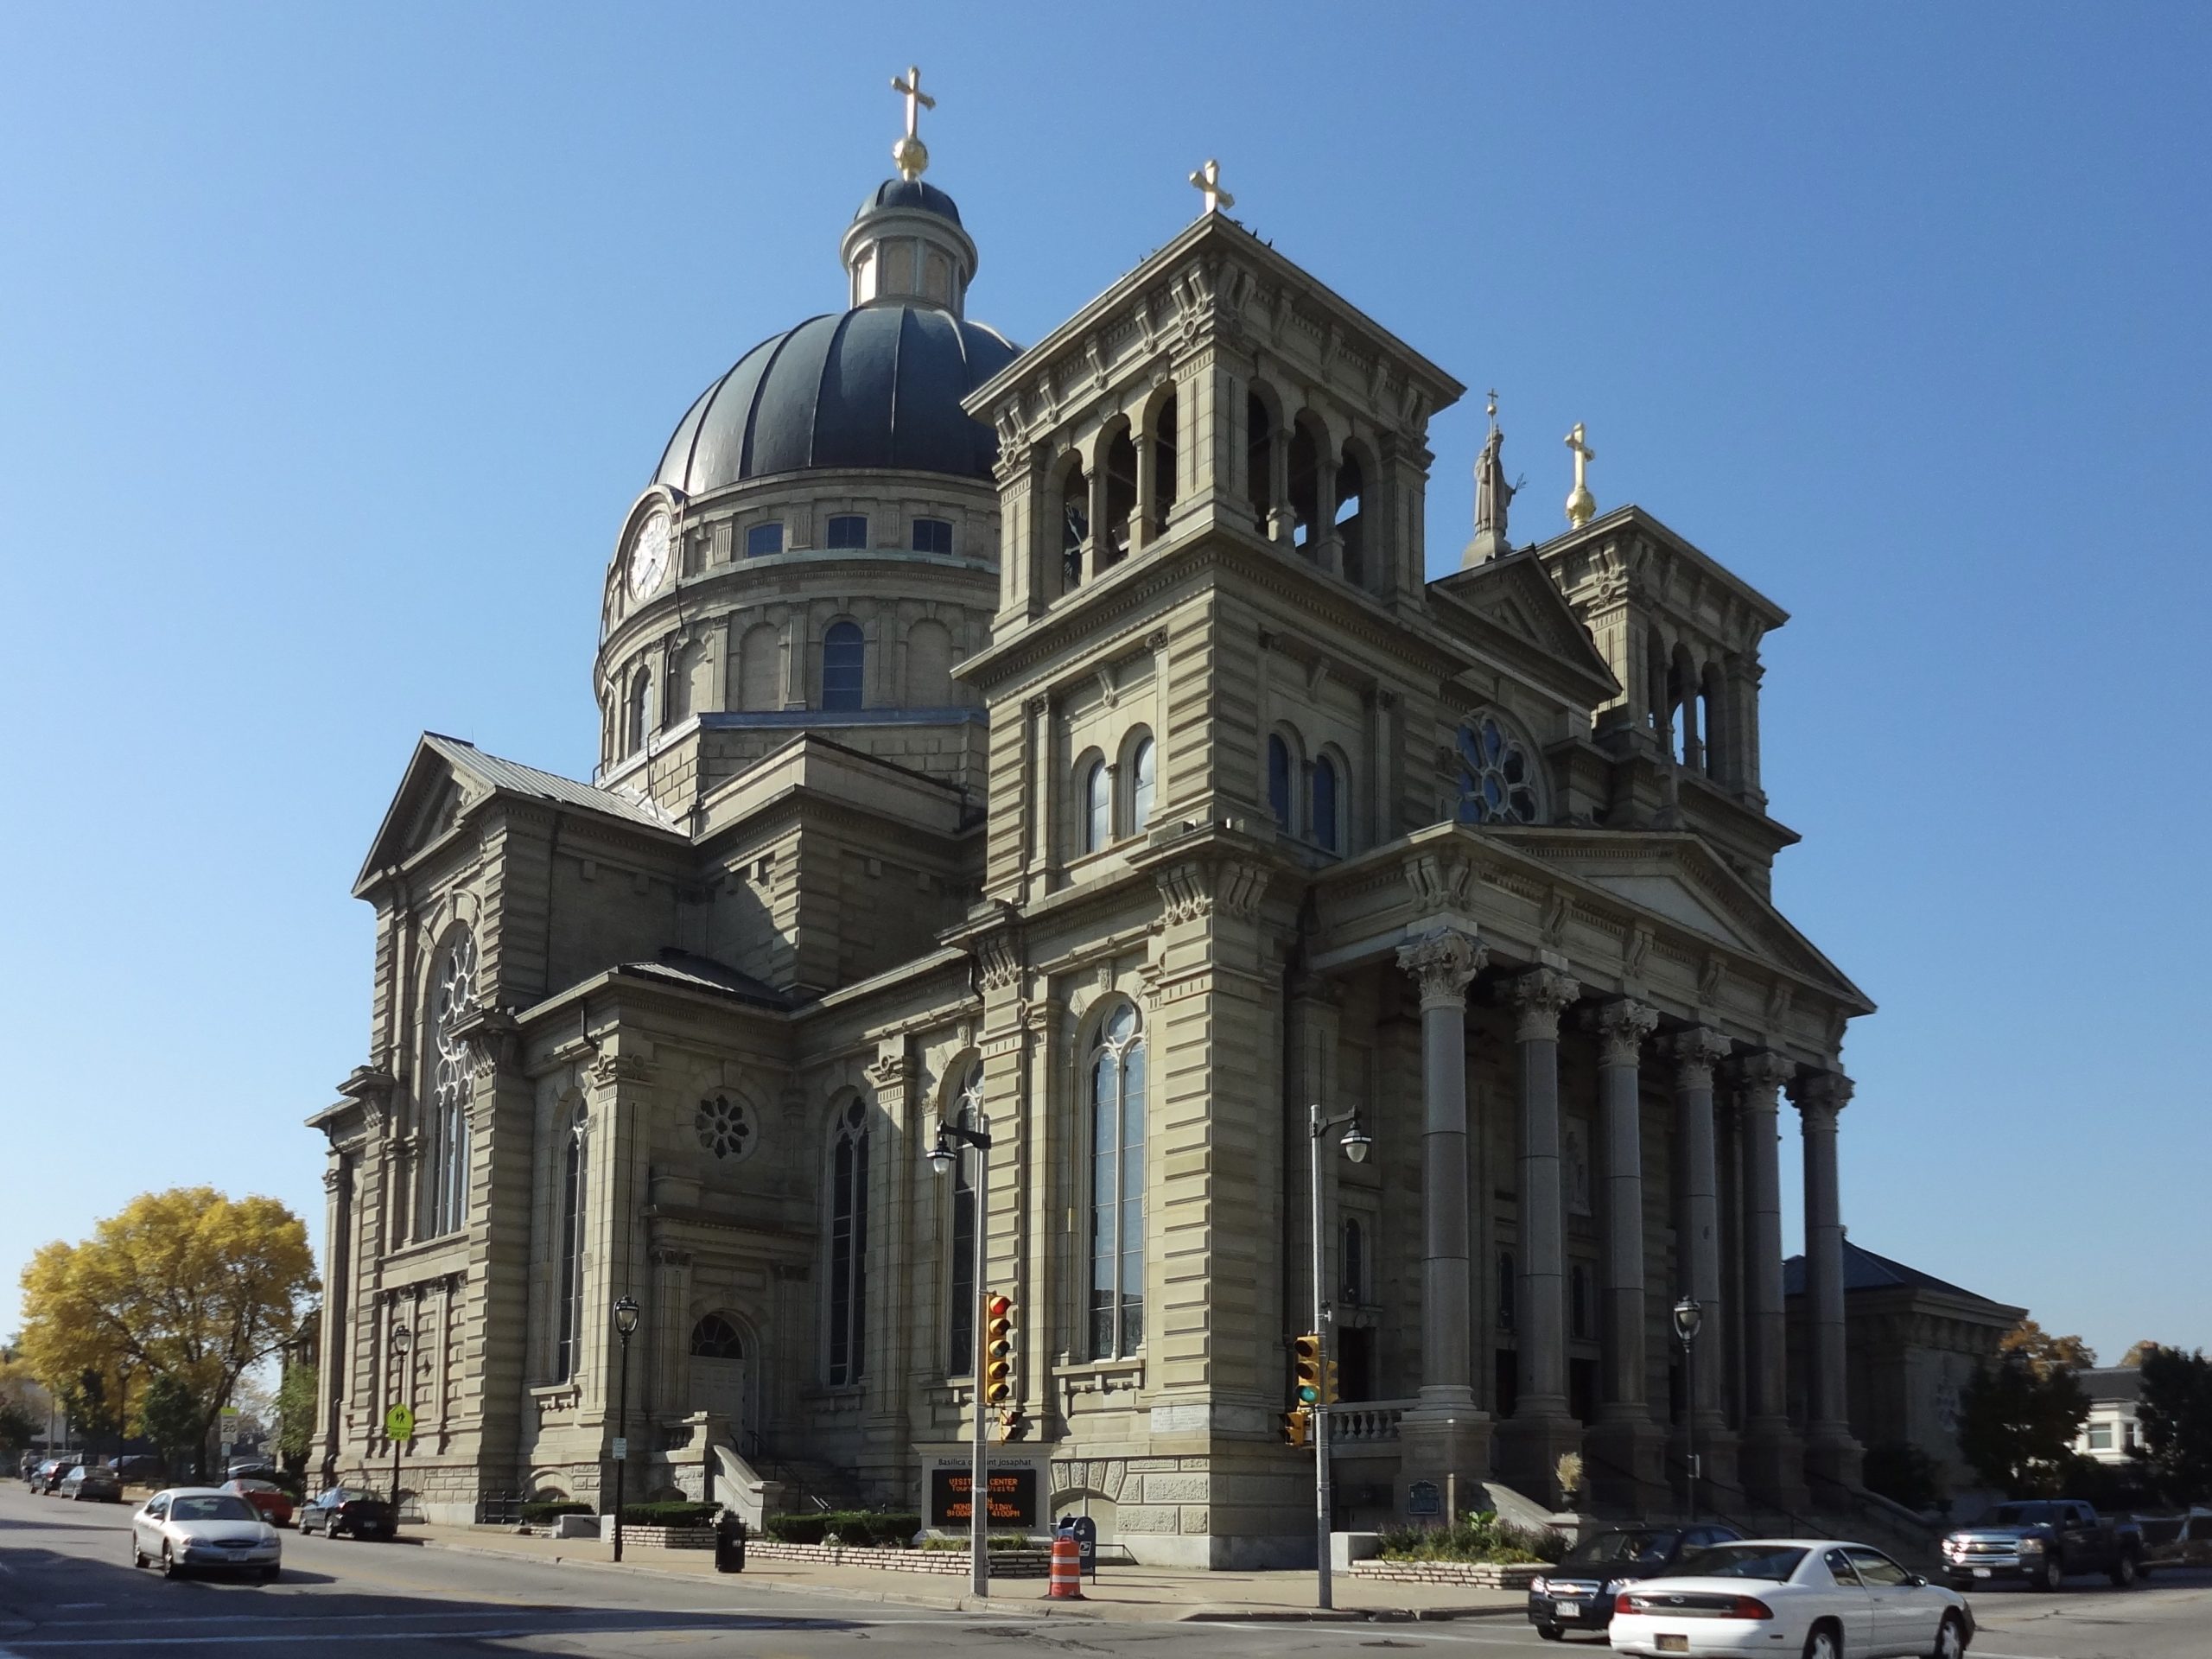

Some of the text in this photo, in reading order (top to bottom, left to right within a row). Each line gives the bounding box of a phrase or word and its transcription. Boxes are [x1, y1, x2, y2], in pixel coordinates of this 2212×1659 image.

[223, 1424, 236, 1433] 20
[938, 1458, 966, 1466] Basilica
[998, 1458, 1032, 1467] Josaphat
[989, 1478, 1018, 1486] CENTER
